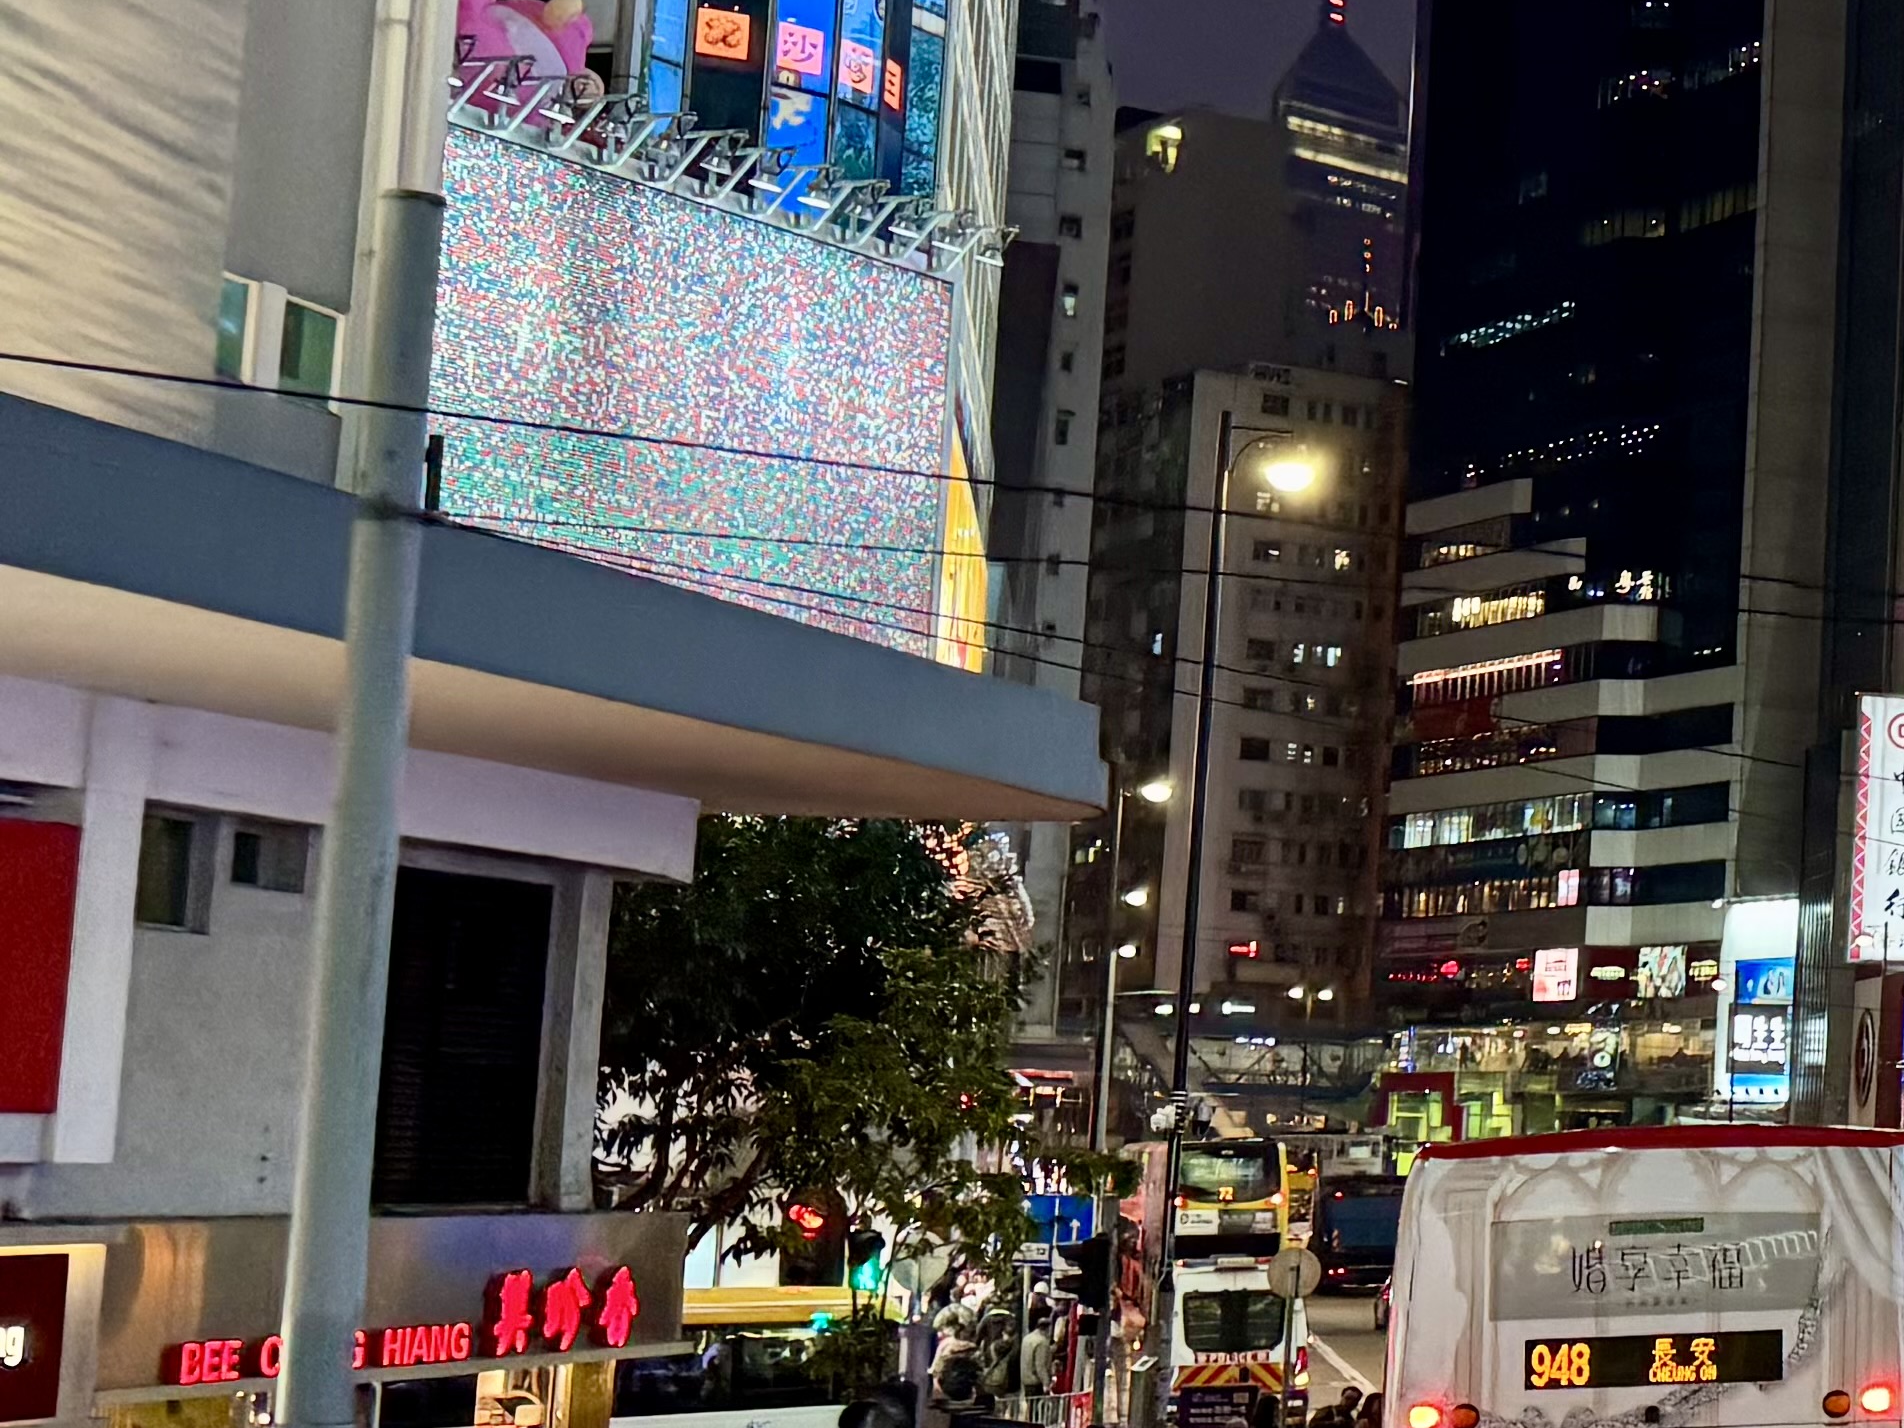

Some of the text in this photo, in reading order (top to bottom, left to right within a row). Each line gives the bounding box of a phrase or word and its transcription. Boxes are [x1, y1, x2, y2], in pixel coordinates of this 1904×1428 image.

[180, 1340, 243, 1385] BEE
[383, 1322, 471, 1367] HIANG
[1530, 1343, 1591, 1387] 948
[1651, 1338, 1716, 1367] 長安
[1649, 1363, 1717, 1383] CHEUNG ON
